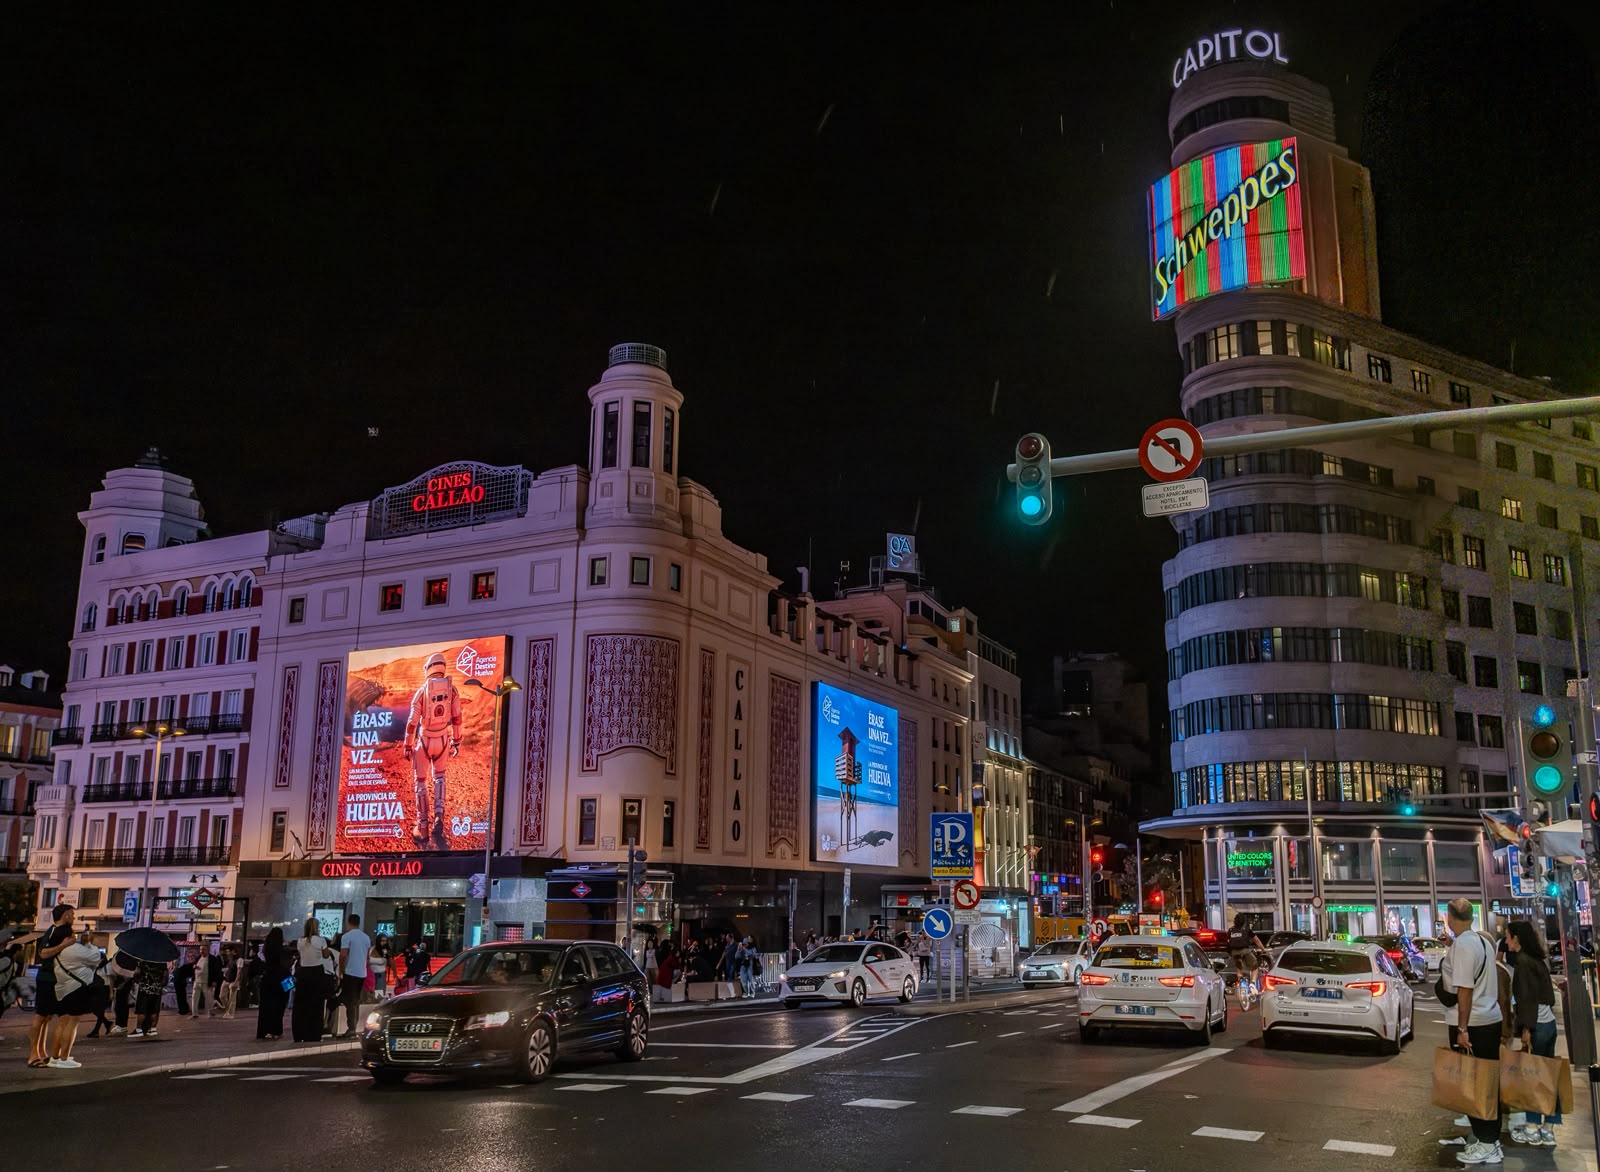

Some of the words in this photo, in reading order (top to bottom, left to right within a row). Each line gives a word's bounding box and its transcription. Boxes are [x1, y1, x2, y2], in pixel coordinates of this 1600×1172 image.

[1173, 28, 1289, 89] CAPITOL
[1155, 146, 1297, 307] Schweppes
[428, 472, 472, 492] CINES
[1162, 484, 1186, 492] EXCEPTO
[412, 485, 485, 512] CALLAO
[1145, 493, 1166, 501] ACCESO
[1166, 488, 1203, 498] APARCAMIENTO
[1164, 501, 1192, 510] BICICLETAS
[476, 656, 497, 664] Agencia
[353, 710, 393, 729] ÉRASE
[868, 710, 885, 729] ÉRASE
[352, 731, 380, 747] UNA
[868, 727, 880, 743] UNA
[351, 748, 383, 765] VEZ...
[731, 670, 744, 842] CALLAO
[868, 768, 892, 788] HUELVA
[347, 794, 355, 802] LA
[355, 792, 388, 801] PROVINCIA
[388, 792, 397, 800] DE
[346, 801, 405, 822] HUELVA
[1247, 852, 1272, 860] COLORS
[322, 862, 361, 877] CINES
[369, 860, 422, 876] CALLAO
[1150, 928, 1161, 936] TAXI
[397, 1039, 419, 1050] 5690
